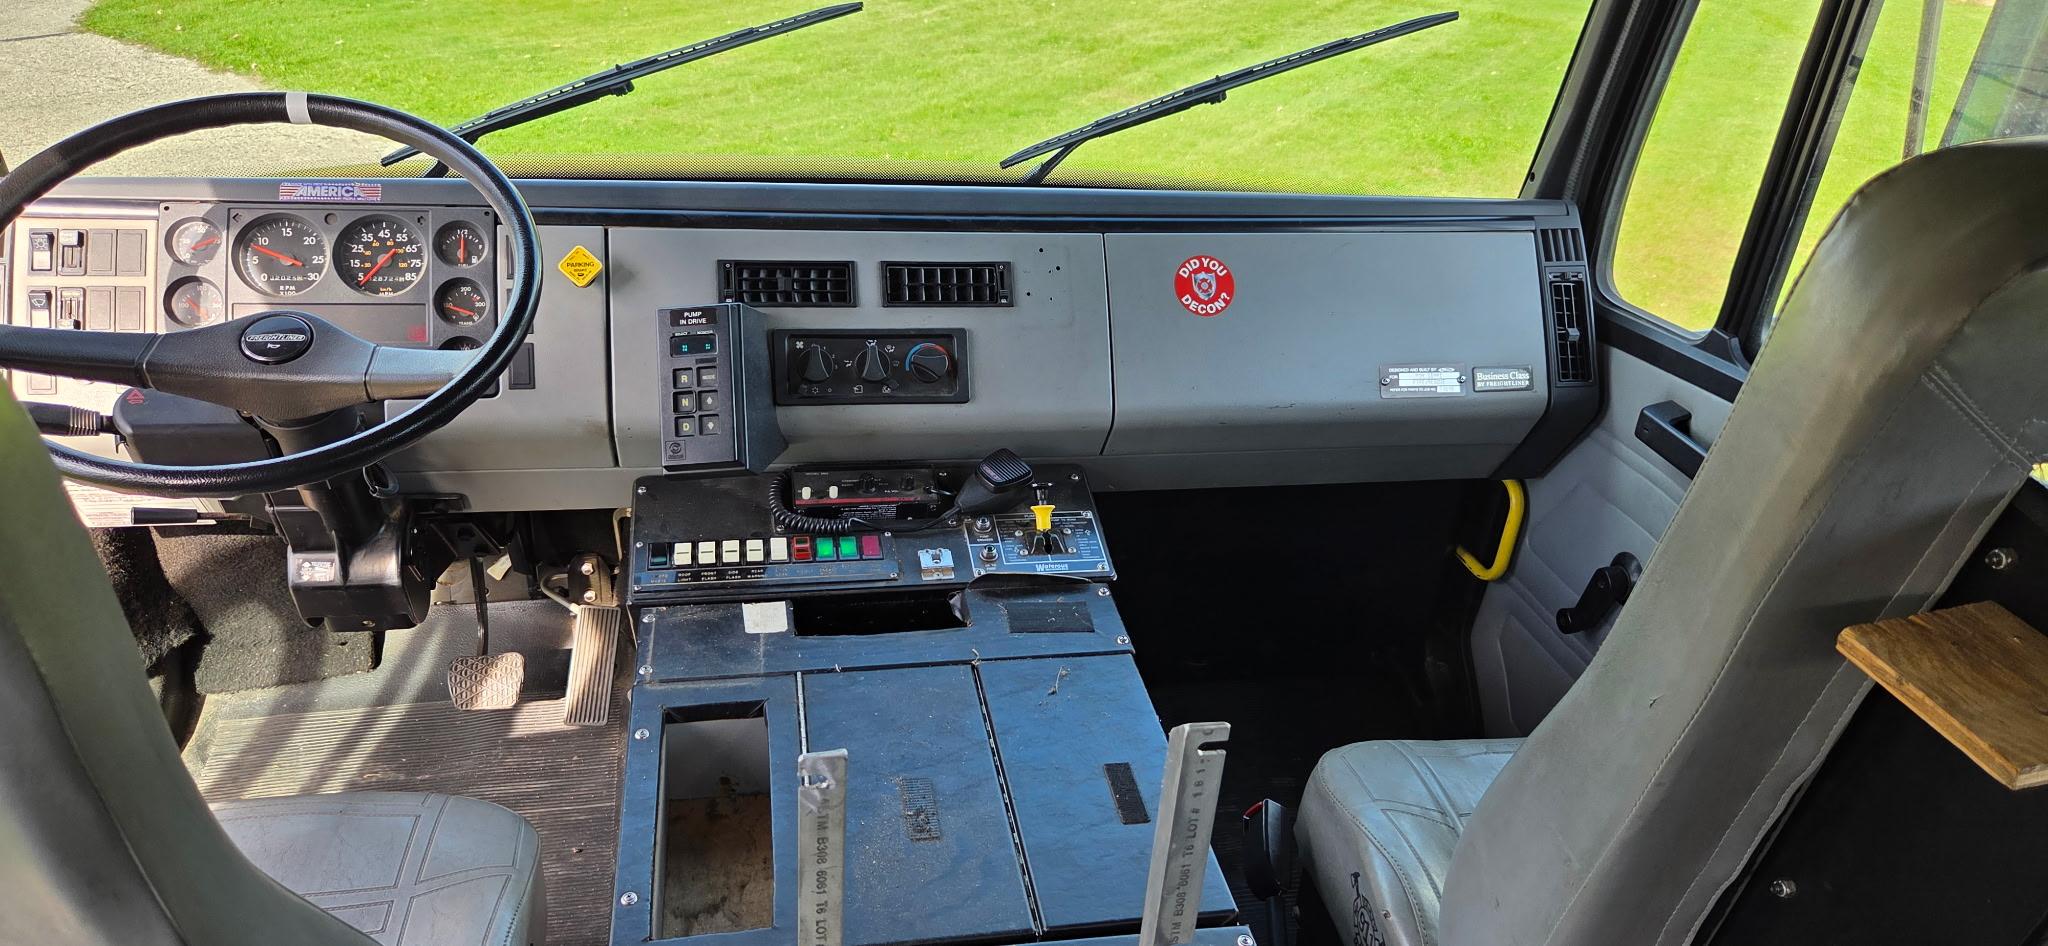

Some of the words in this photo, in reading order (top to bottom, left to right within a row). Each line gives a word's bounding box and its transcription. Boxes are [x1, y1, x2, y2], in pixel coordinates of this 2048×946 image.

[295, 184, 365, 197] AMERICA
[281, 228, 293, 237] 15
[378, 230, 391, 238] 45
[258, 237, 269, 245] 10
[303, 236, 316, 245] 20
[361, 233, 374, 242] 35
[396, 234, 408, 242] 55
[352, 244, 364, 253] 25
[406, 244, 418, 253] 65
[252, 256, 259, 264] 5
[312, 256, 324, 264] 25
[350, 260, 360, 268] 15
[410, 260, 422, 268] 75
[1178, 258, 1200, 278] DID
[1201, 257, 1228, 276] YOU
[261, 273, 268, 281] 0
[308, 272, 320, 281] 30
[358, 273, 364, 281] 5
[405, 272, 417, 281] 85
[1181, 292, 1230, 314] DECON?
[681, 374, 688, 384] R
[1476, 372, 1509, 380] Business
[1510, 371, 1530, 380] Class
[682, 398, 689, 407] N
[682, 422, 690, 432] D
[1184, 816, 1200, 839] LOT
[816, 836, 829, 865] B308
[1182, 844, 1195, 858] T6
[816, 870, 827, 894] 6061
[816, 900, 828, 914] T6
[1174, 892, 1186, 917] B308
[816, 918, 828, 941] LOT
